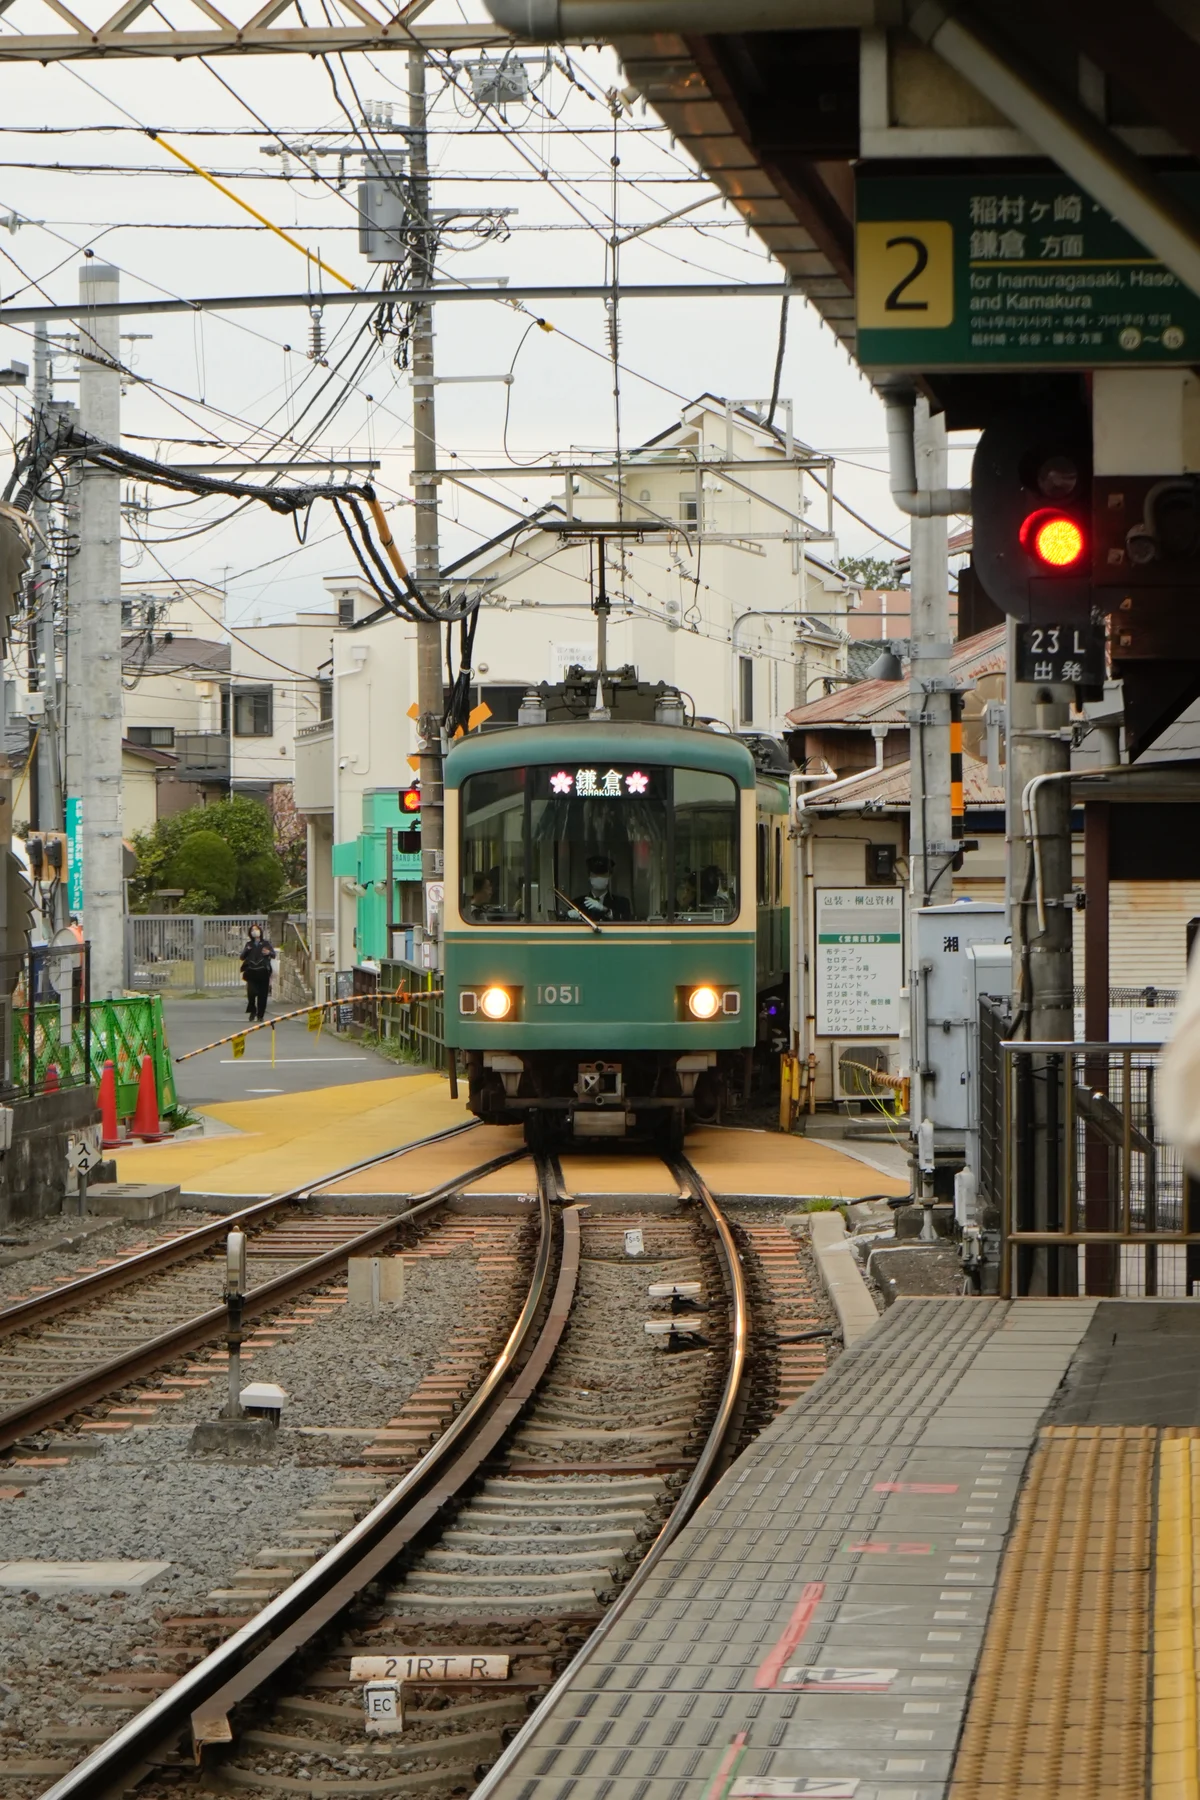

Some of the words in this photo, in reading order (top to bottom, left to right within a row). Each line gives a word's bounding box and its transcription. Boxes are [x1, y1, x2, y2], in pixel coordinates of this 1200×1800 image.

[969, 229, 1027, 258] 鎌倉
[1039, 234, 1084, 258] 方面
[885, 236, 928, 311] 2
[969, 273, 991, 289] for
[997, 271, 1125, 291] Inamuragasaki,
[970, 294, 1001, 311] and
[1006, 293, 1092, 310] Kamakura
[1031, 629, 1060, 653] 23
[1073, 631, 1085, 653] L
[1033, 661, 1083, 682] 出発
[575, 768, 623, 790] 鎌倉
[577, 788, 622, 797] KAMAKURA
[943, 936, 959, 952] 湘
[537, 986, 580, 1004] 1051
[78, 1142, 91, 1156] 入
[78, 1158, 90, 1170] 4
[471, 1658, 488, 1677] R
[373, 1698, 392, 1712] EC
